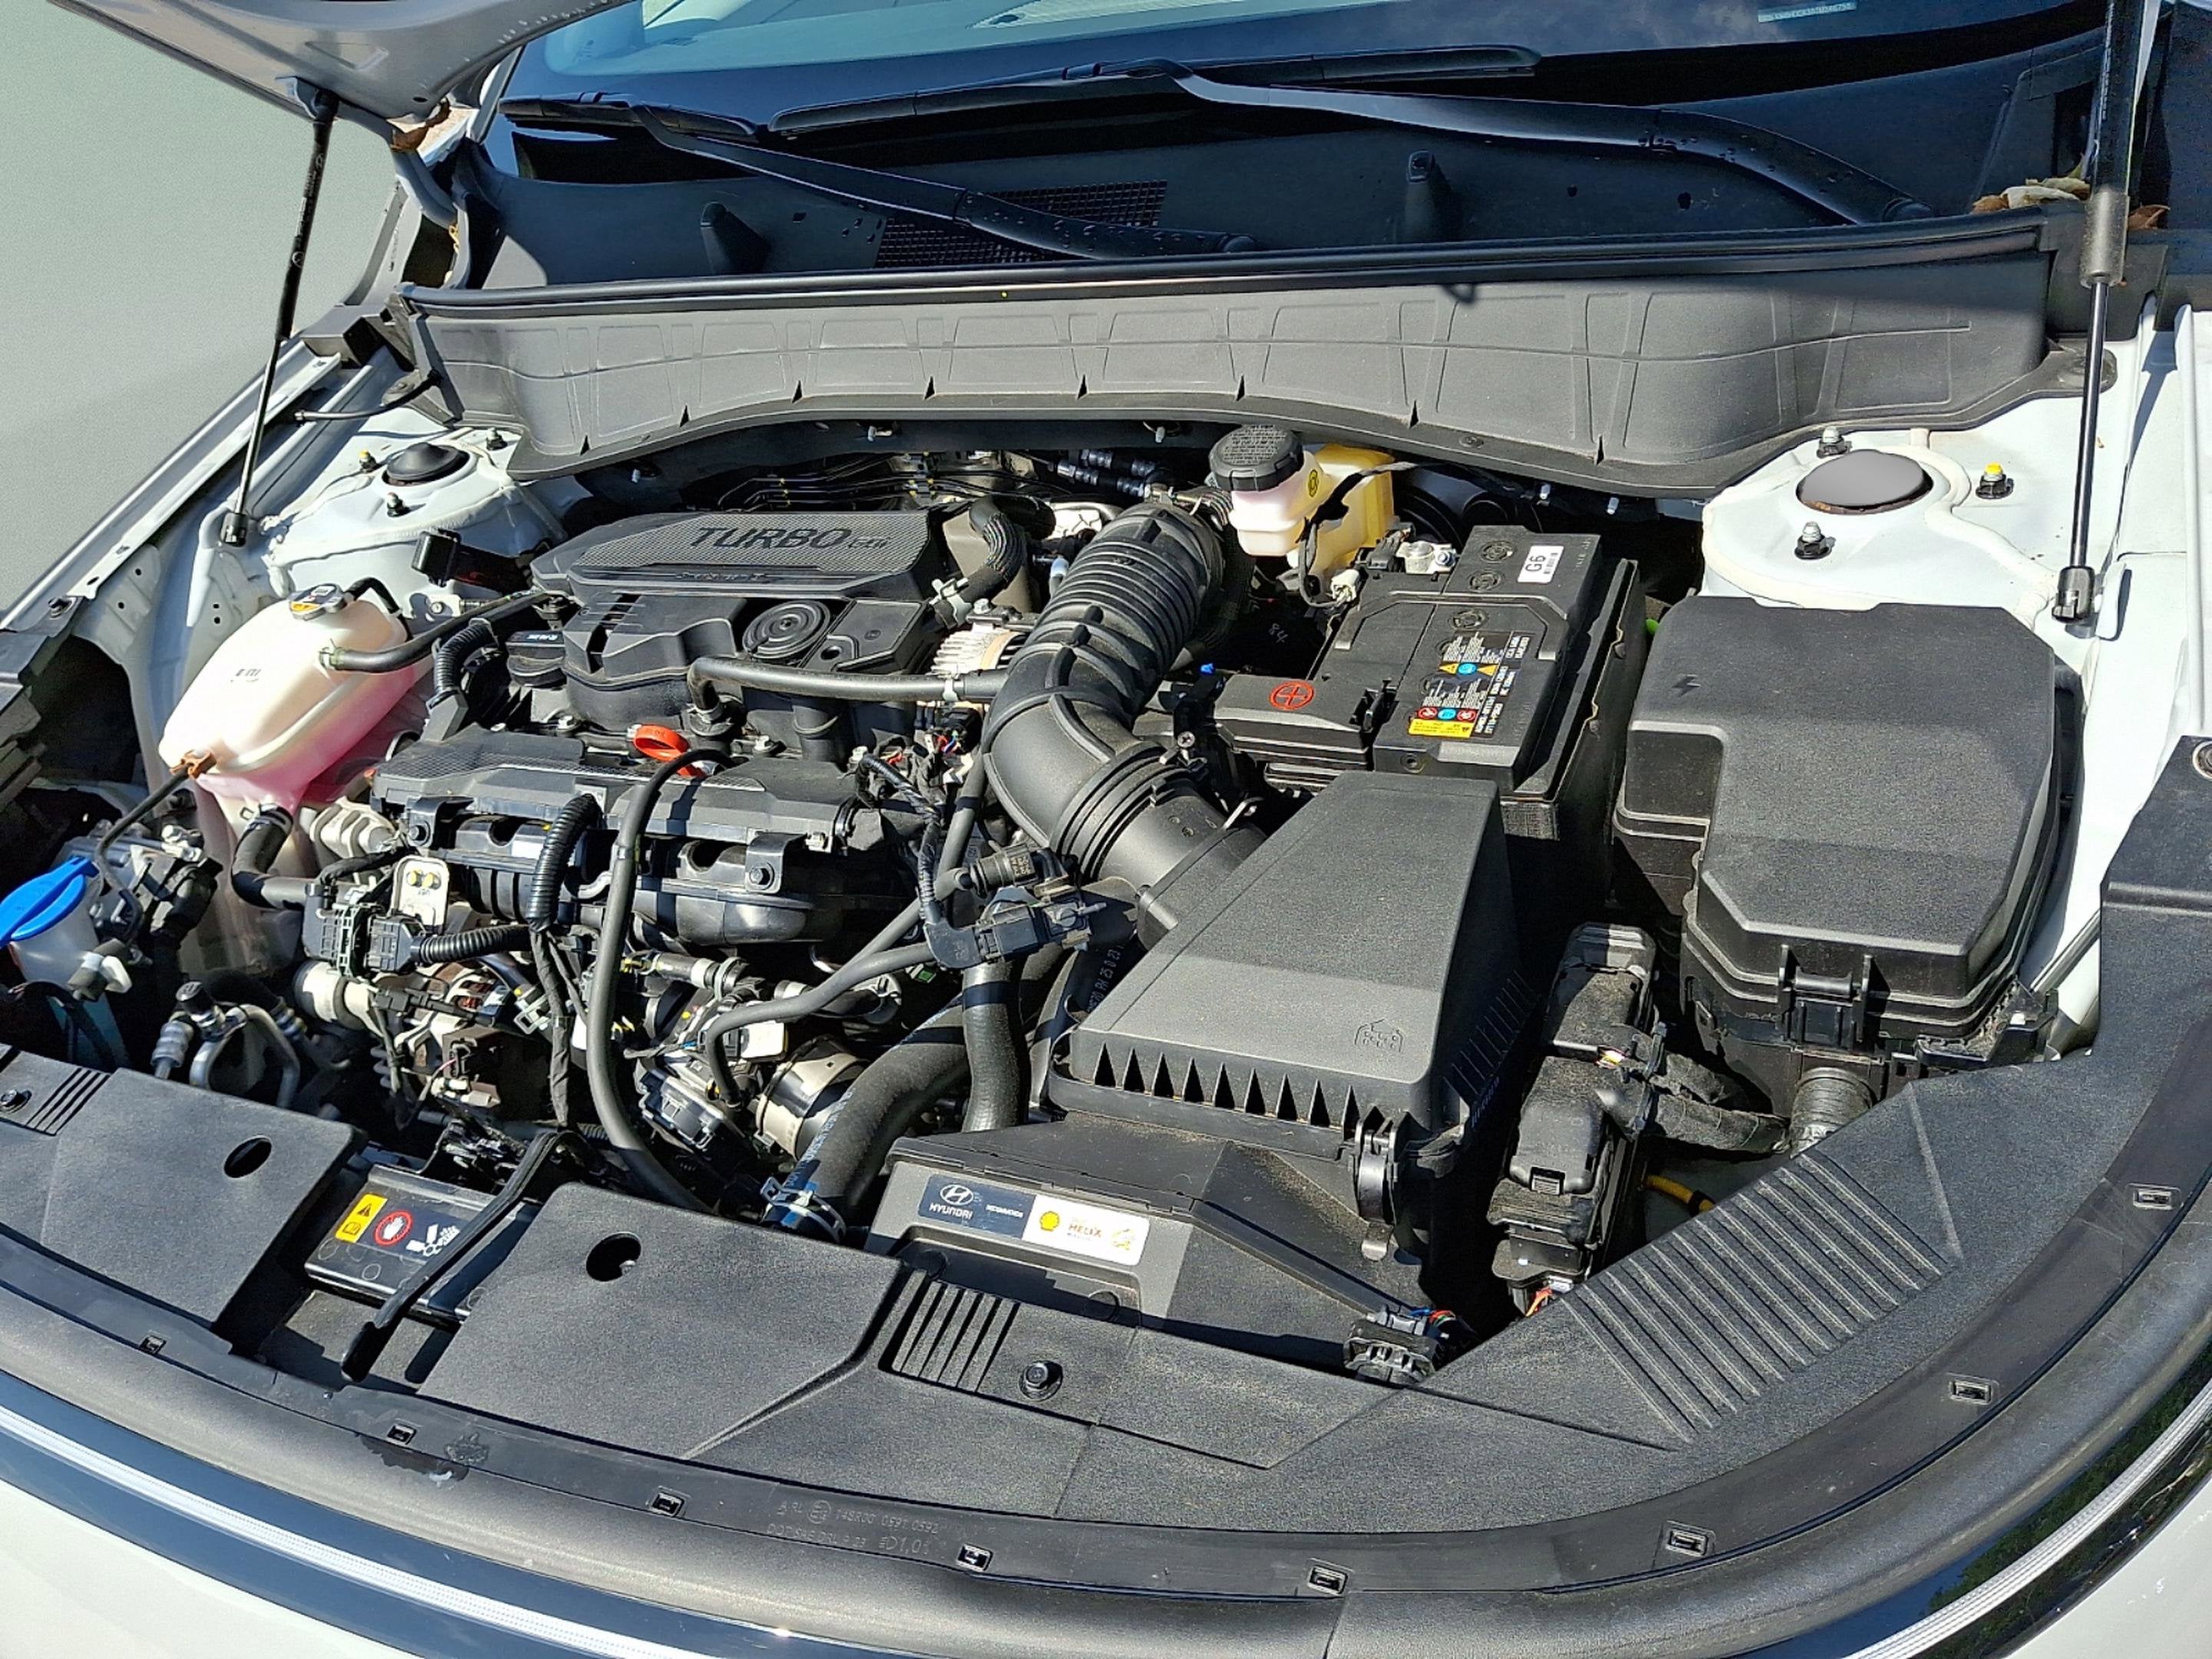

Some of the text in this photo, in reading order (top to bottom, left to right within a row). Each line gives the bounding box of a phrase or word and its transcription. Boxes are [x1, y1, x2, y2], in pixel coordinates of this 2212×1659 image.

[691, 527, 852, 549] TURBO
[1525, 555, 1546, 572] G6
[929, 1203, 973, 1220] HYUNDAI
[1069, 1224, 1103, 1238] HELIX
